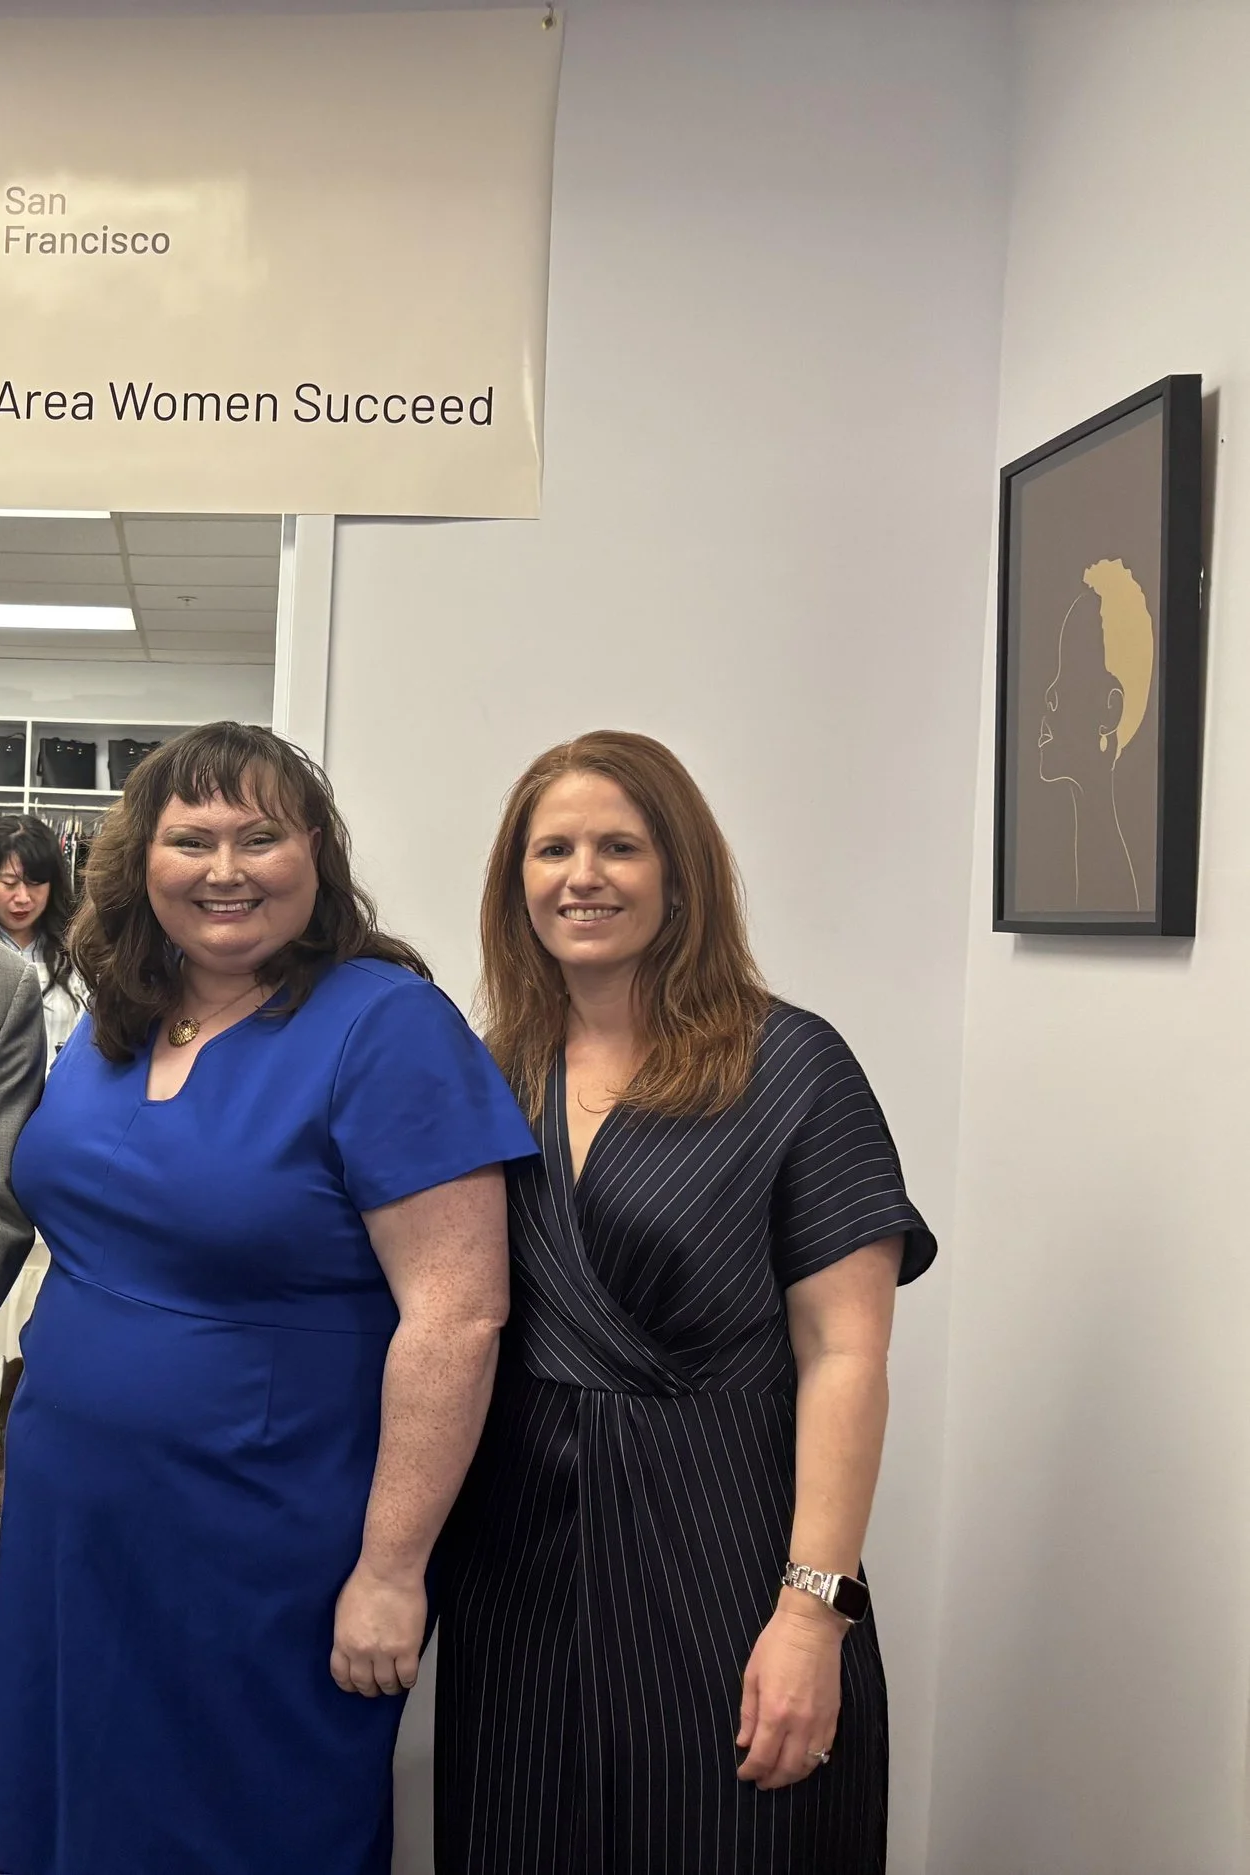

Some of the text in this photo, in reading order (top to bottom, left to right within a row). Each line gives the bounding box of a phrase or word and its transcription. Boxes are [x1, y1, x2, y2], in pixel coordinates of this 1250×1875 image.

[5, 186, 67, 216] San
[4, 225, 171, 255] Francisco
[108, 382, 278, 423] Women
[293, 383, 494, 426] Succeed
